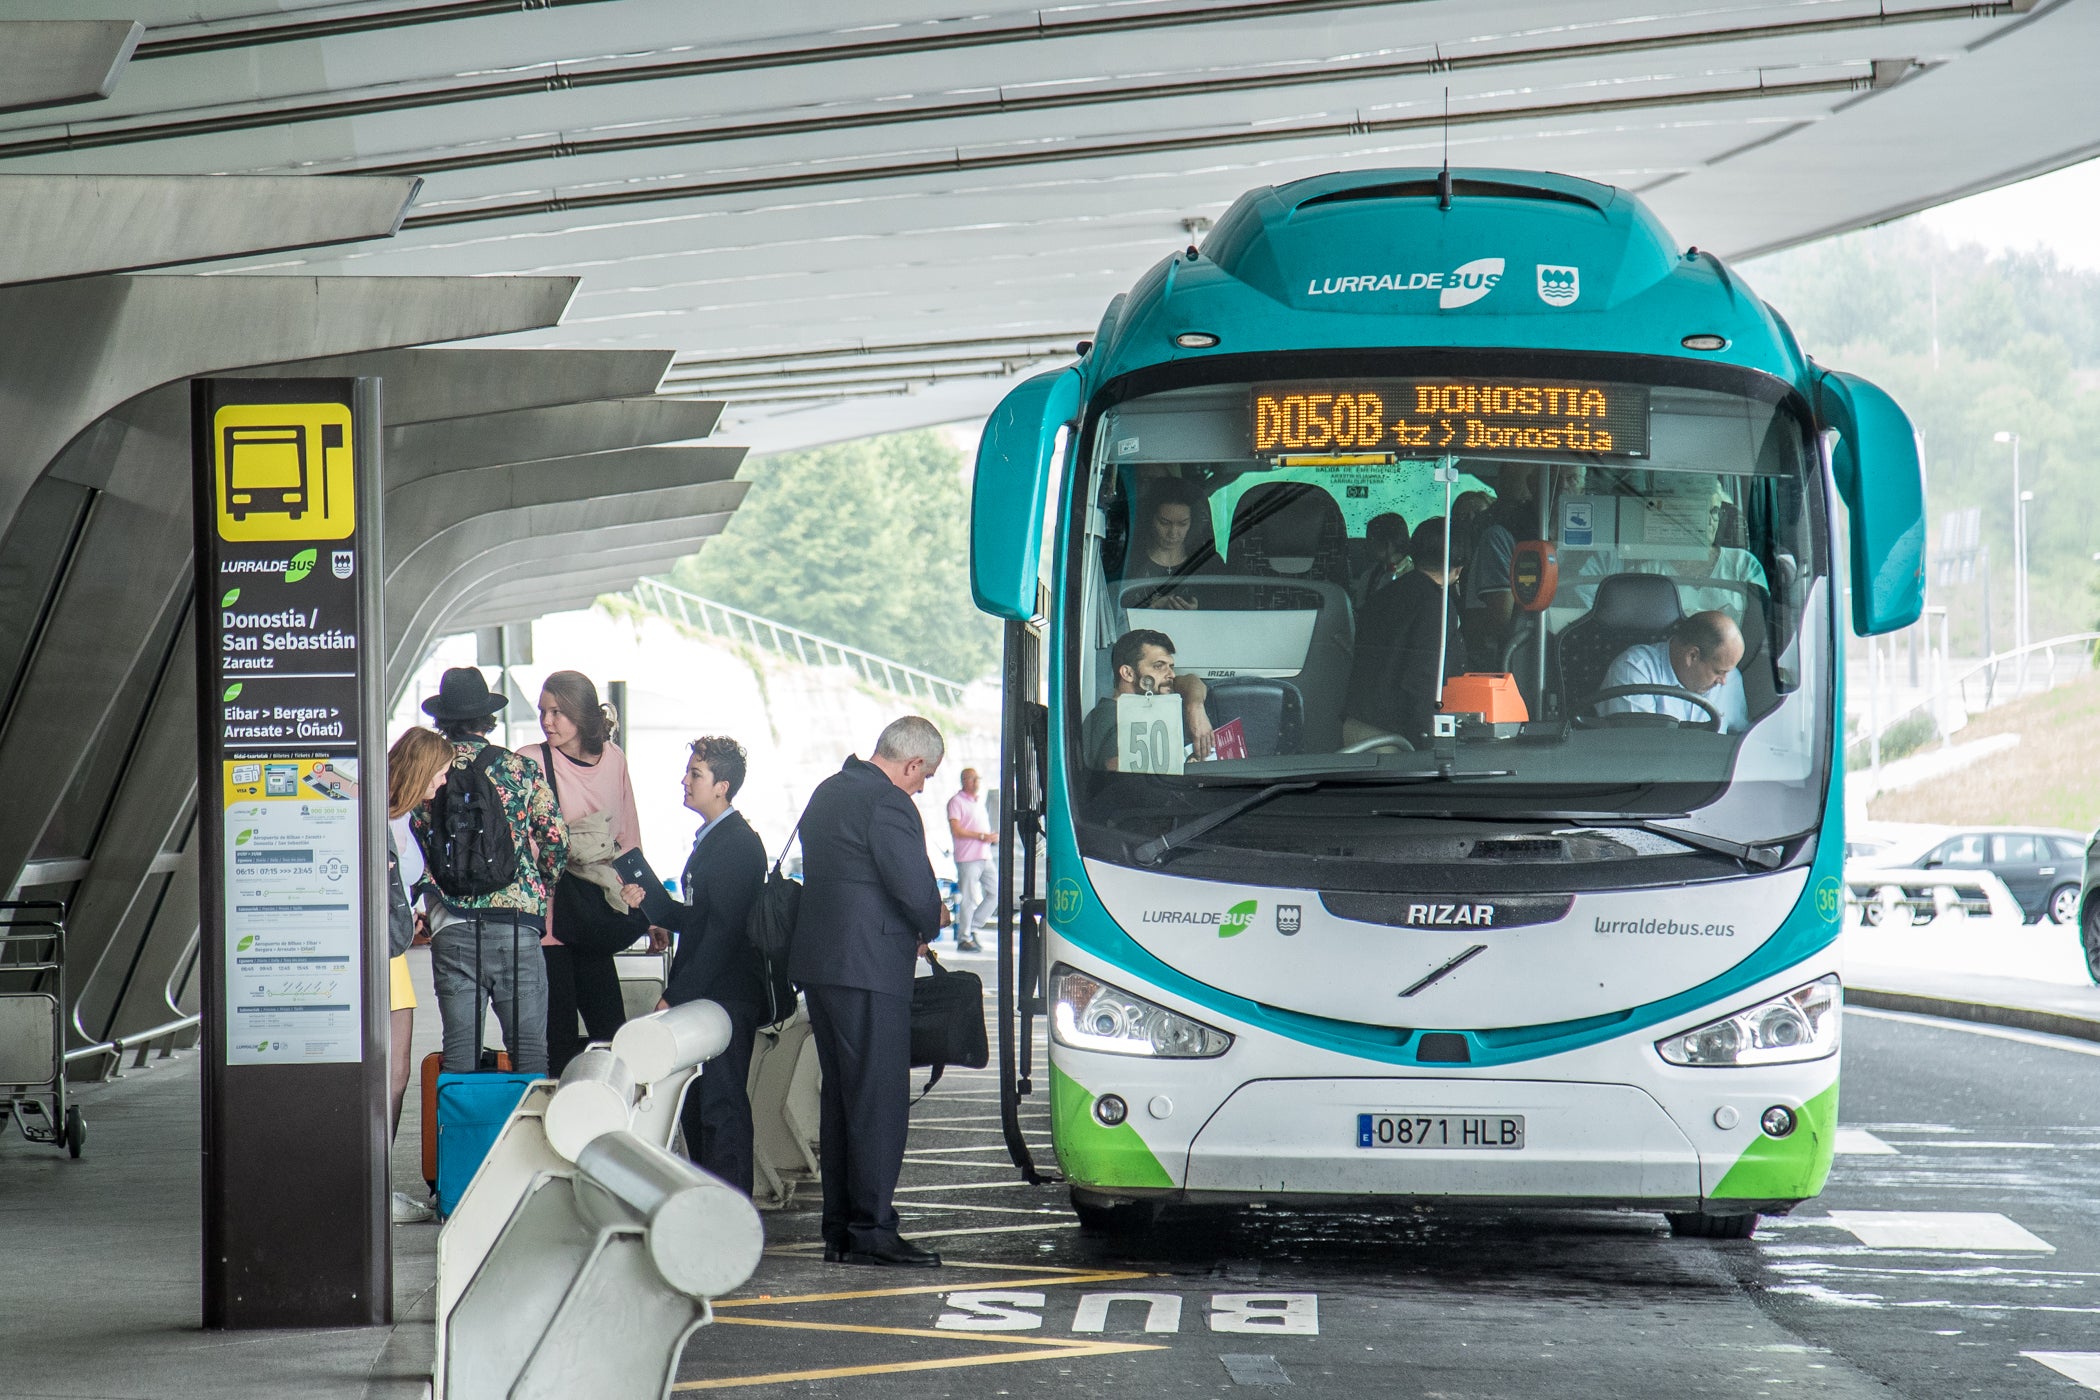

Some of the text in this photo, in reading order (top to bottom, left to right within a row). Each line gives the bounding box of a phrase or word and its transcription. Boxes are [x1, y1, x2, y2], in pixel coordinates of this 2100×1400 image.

[1415, 385, 1606, 417] DONOSTIA
[1463, 419, 1612, 451] Donostia
[222, 608, 306, 629] Donostia
[222, 630, 356, 651] San Sebastián
[222, 656, 274, 669] Zarautz
[1207, 670, 1236, 678] IRIZAR
[224, 706, 259, 720] Eibar
[273, 707, 327, 722] Bergara
[224, 725, 282, 738] Arrasate
[296, 722, 343, 738] (Oñati)
[1129, 719, 1170, 775] 50
[1054, 888, 1080, 912] 367
[1407, 903, 1495, 926] RIZAR
[1594, 916, 1735, 937] lurraldebus.eus
[1362, 1133, 1370, 1142] E
[1378, 1118, 1517, 1145] 0871 HLB
[934, 1291, 1320, 1335] BUS
